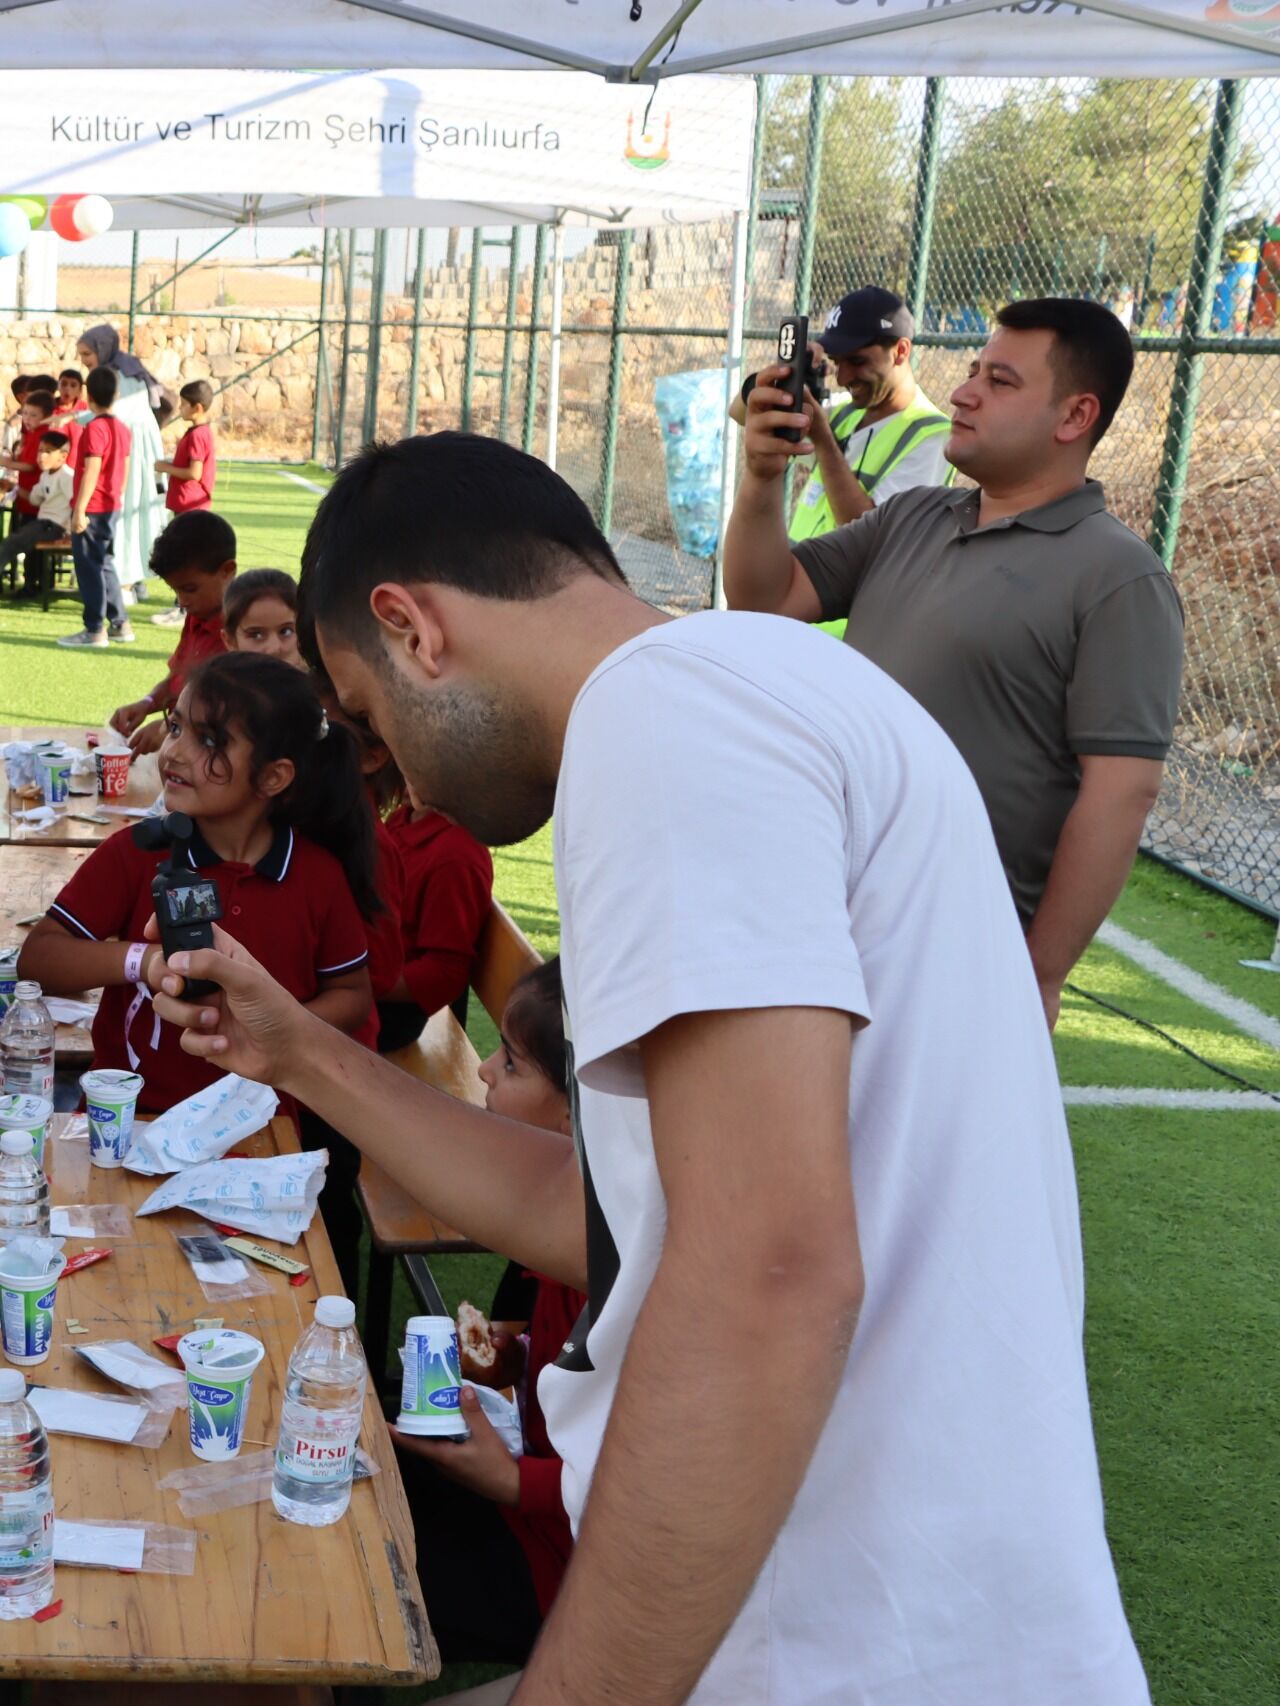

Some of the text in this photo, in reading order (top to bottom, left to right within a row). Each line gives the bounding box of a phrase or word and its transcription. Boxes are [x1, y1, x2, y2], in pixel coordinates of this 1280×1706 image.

[51, 113, 560, 152] Kültür ve Turizm Şehri Şanlıurfa
[96, 772, 126, 795] afé
[35, 1313, 45, 1354] AYRAN
[296, 1439, 347, 1460] Pirsu
